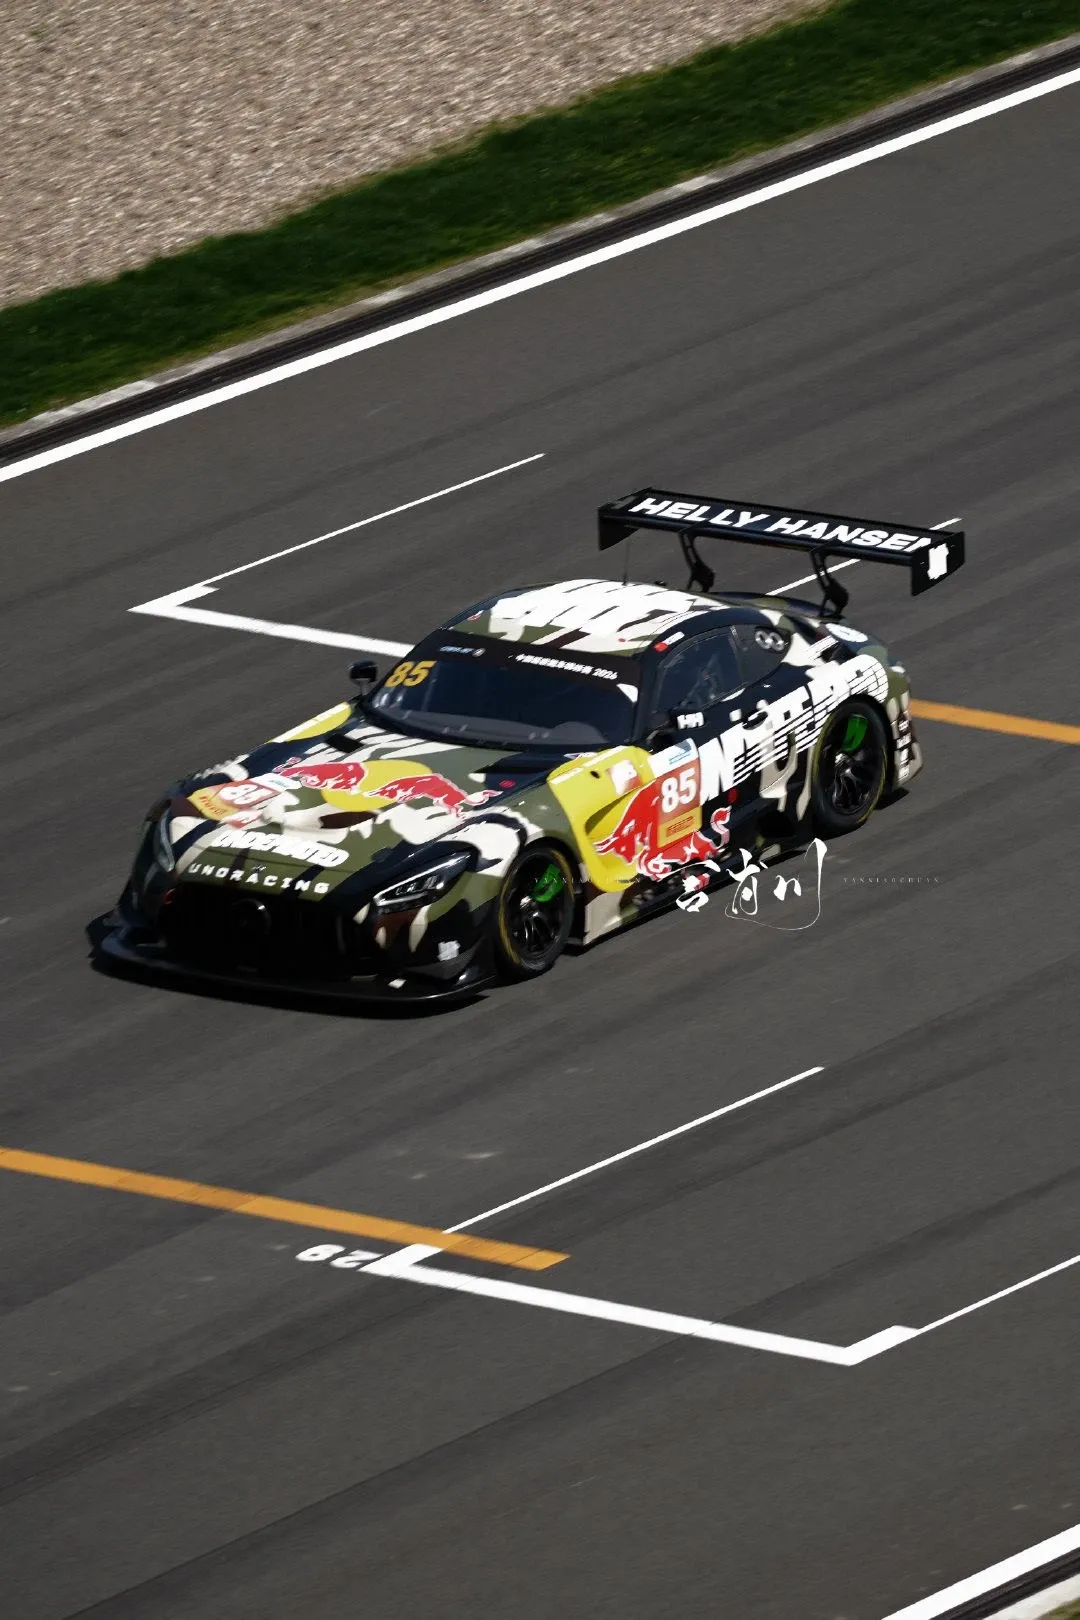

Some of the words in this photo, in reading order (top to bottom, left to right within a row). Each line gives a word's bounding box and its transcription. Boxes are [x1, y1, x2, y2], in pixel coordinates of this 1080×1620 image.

[629, 497, 767, 528] HELLY
[384, 660, 436, 688] 85
[661, 768, 698, 814] 85
